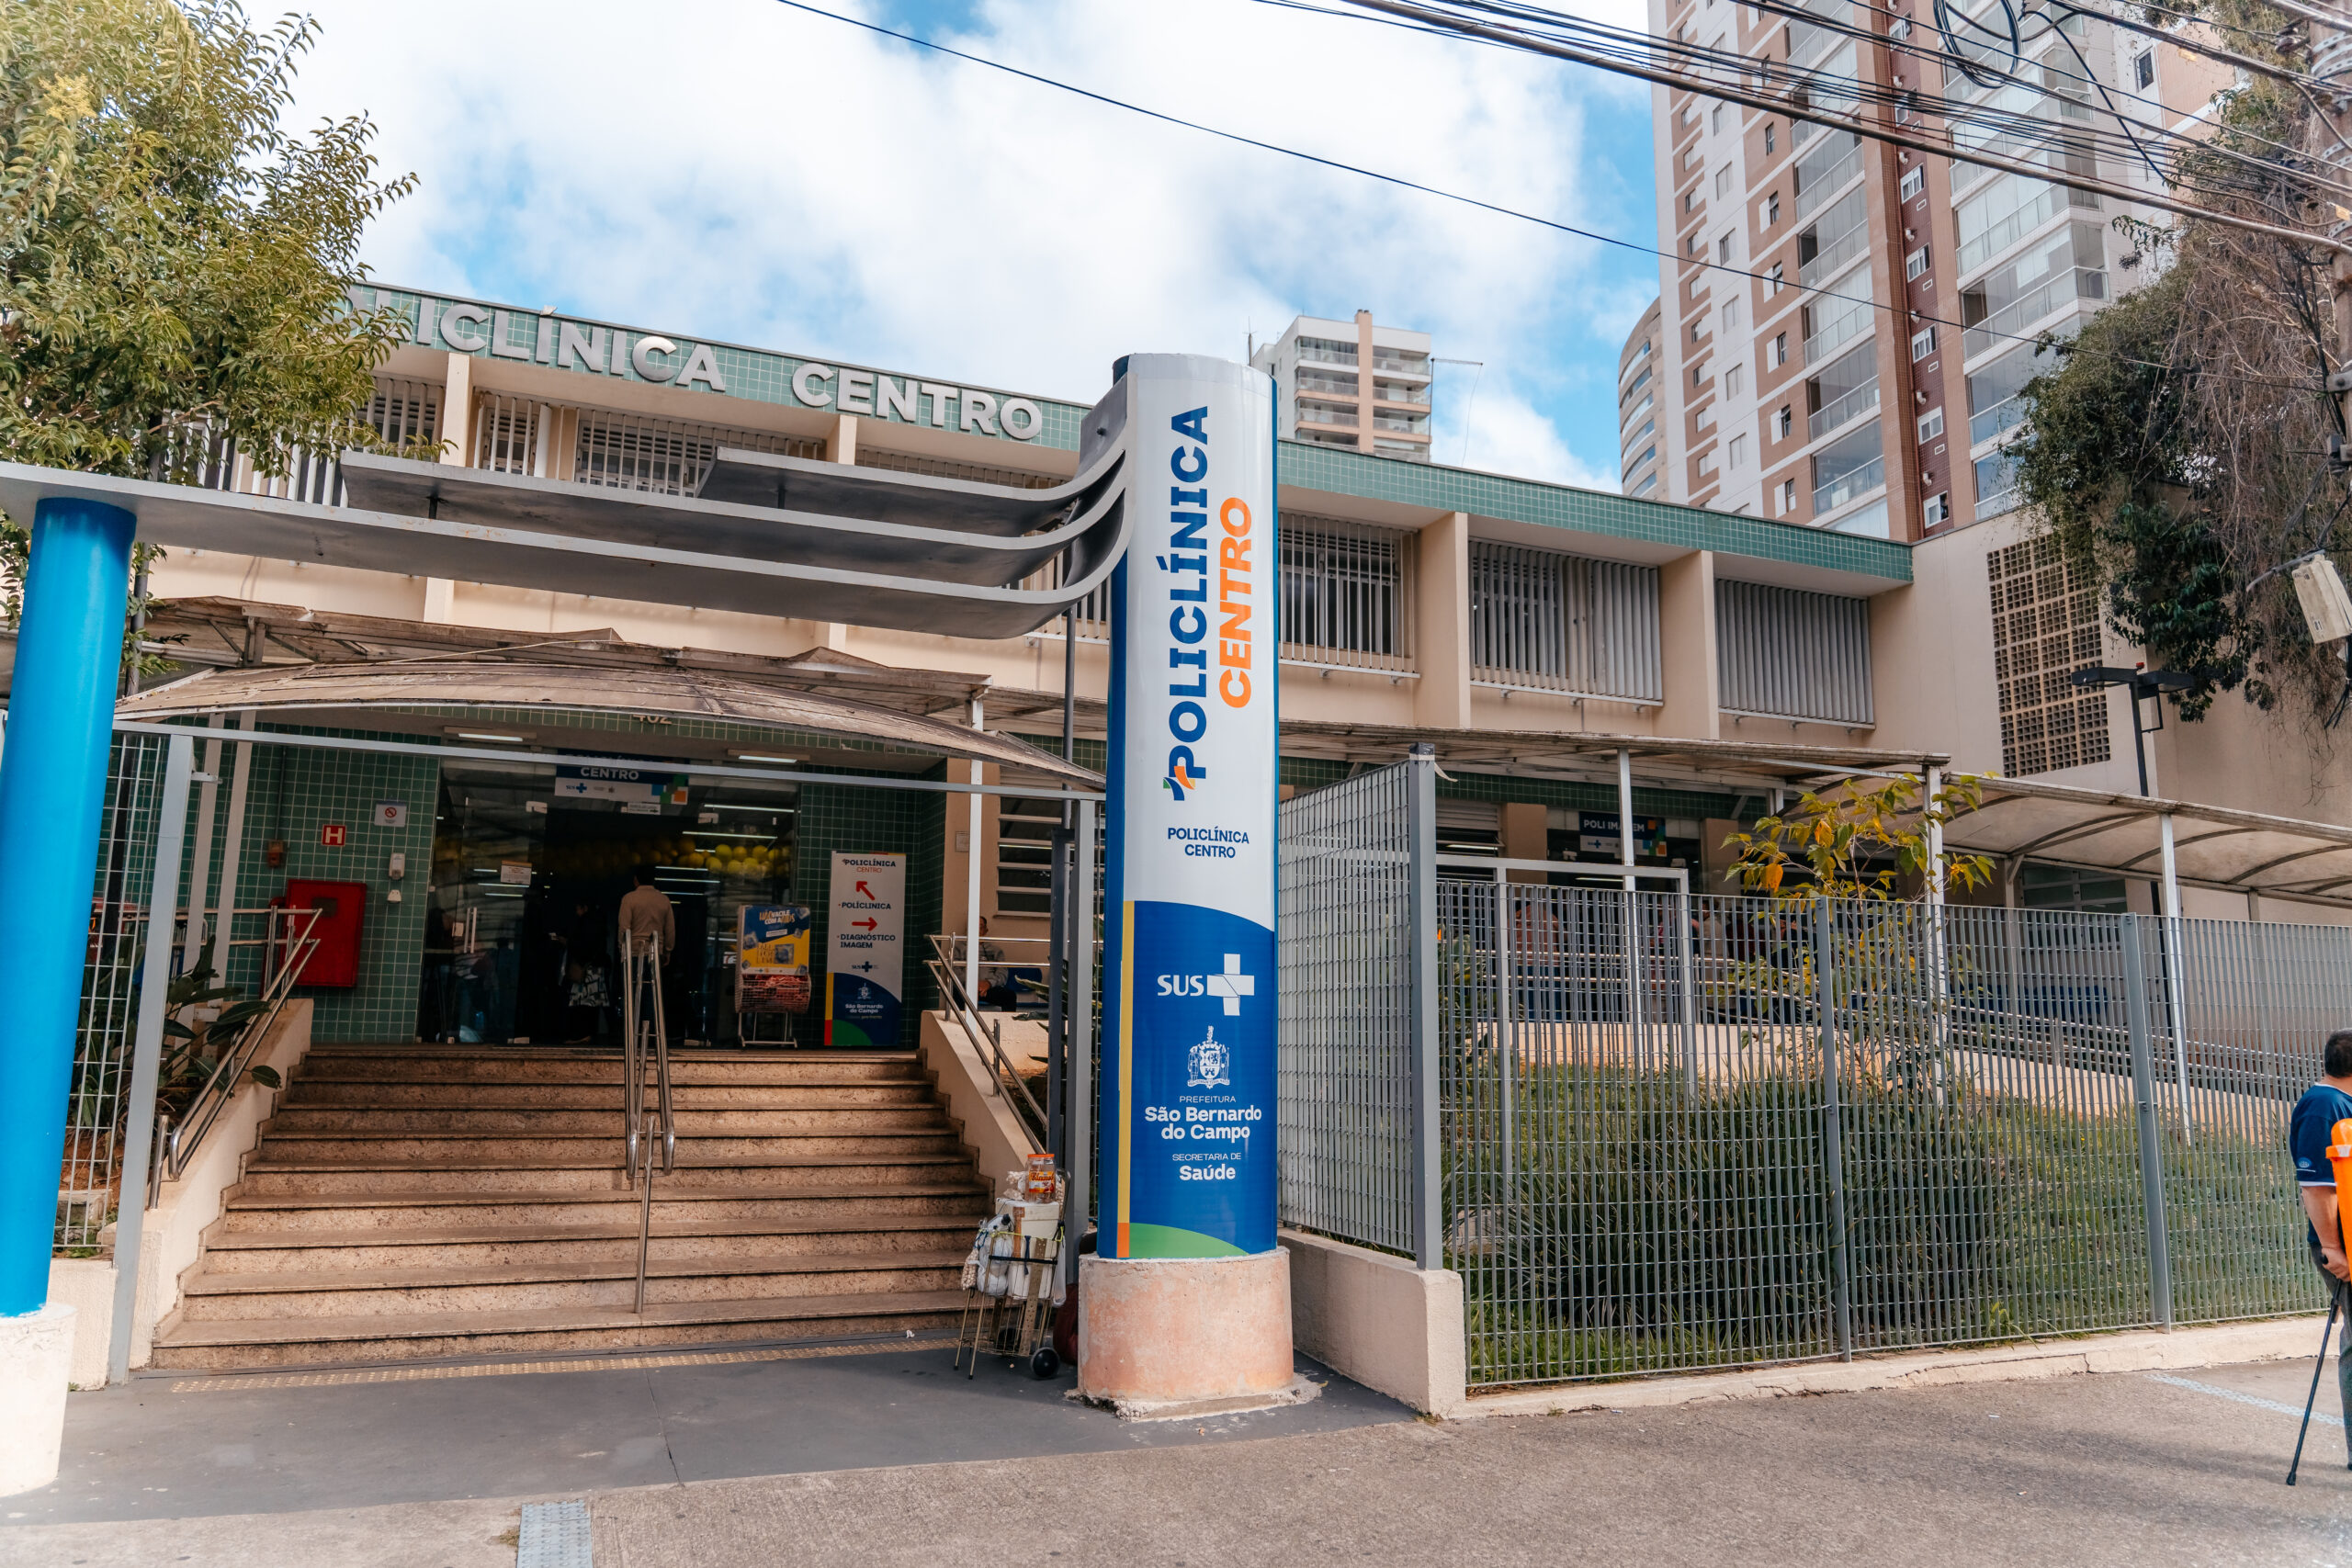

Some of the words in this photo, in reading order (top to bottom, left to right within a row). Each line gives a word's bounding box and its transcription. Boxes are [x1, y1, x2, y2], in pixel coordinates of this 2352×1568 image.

[792, 362, 1043, 440] CENTRO
[1156, 406, 1208, 801] POLICLÍNICA
[1219, 497, 1252, 708] CENTRO
[580, 766, 639, 780] CENTRO
[1583, 819, 1605, 829] POLI
[1607, 821, 1645, 832] IMEM
[324, 827, 344, 844] H
[1168, 826, 1250, 844] POLICLÍNICA
[1184, 843, 1237, 858] CENTRO
[843, 859, 896, 867] POLICLÍNICA
[840, 933, 896, 942] DIAGNÓSTICO
[1157, 974, 1204, 997] SUS
[1179, 1095, 1237, 1103] PREFEITURA
[1145, 1106, 1181, 1122] São
[1185, 1104, 1262, 1122] Bernardo
[1161, 1123, 1185, 1140] do
[1190, 1124, 1250, 1144] Campo
[1171, 1153, 1229, 1161] SECRETARIA
[1230, 1152, 1242, 1160] DE
[1179, 1163, 1236, 1180] Saúde
